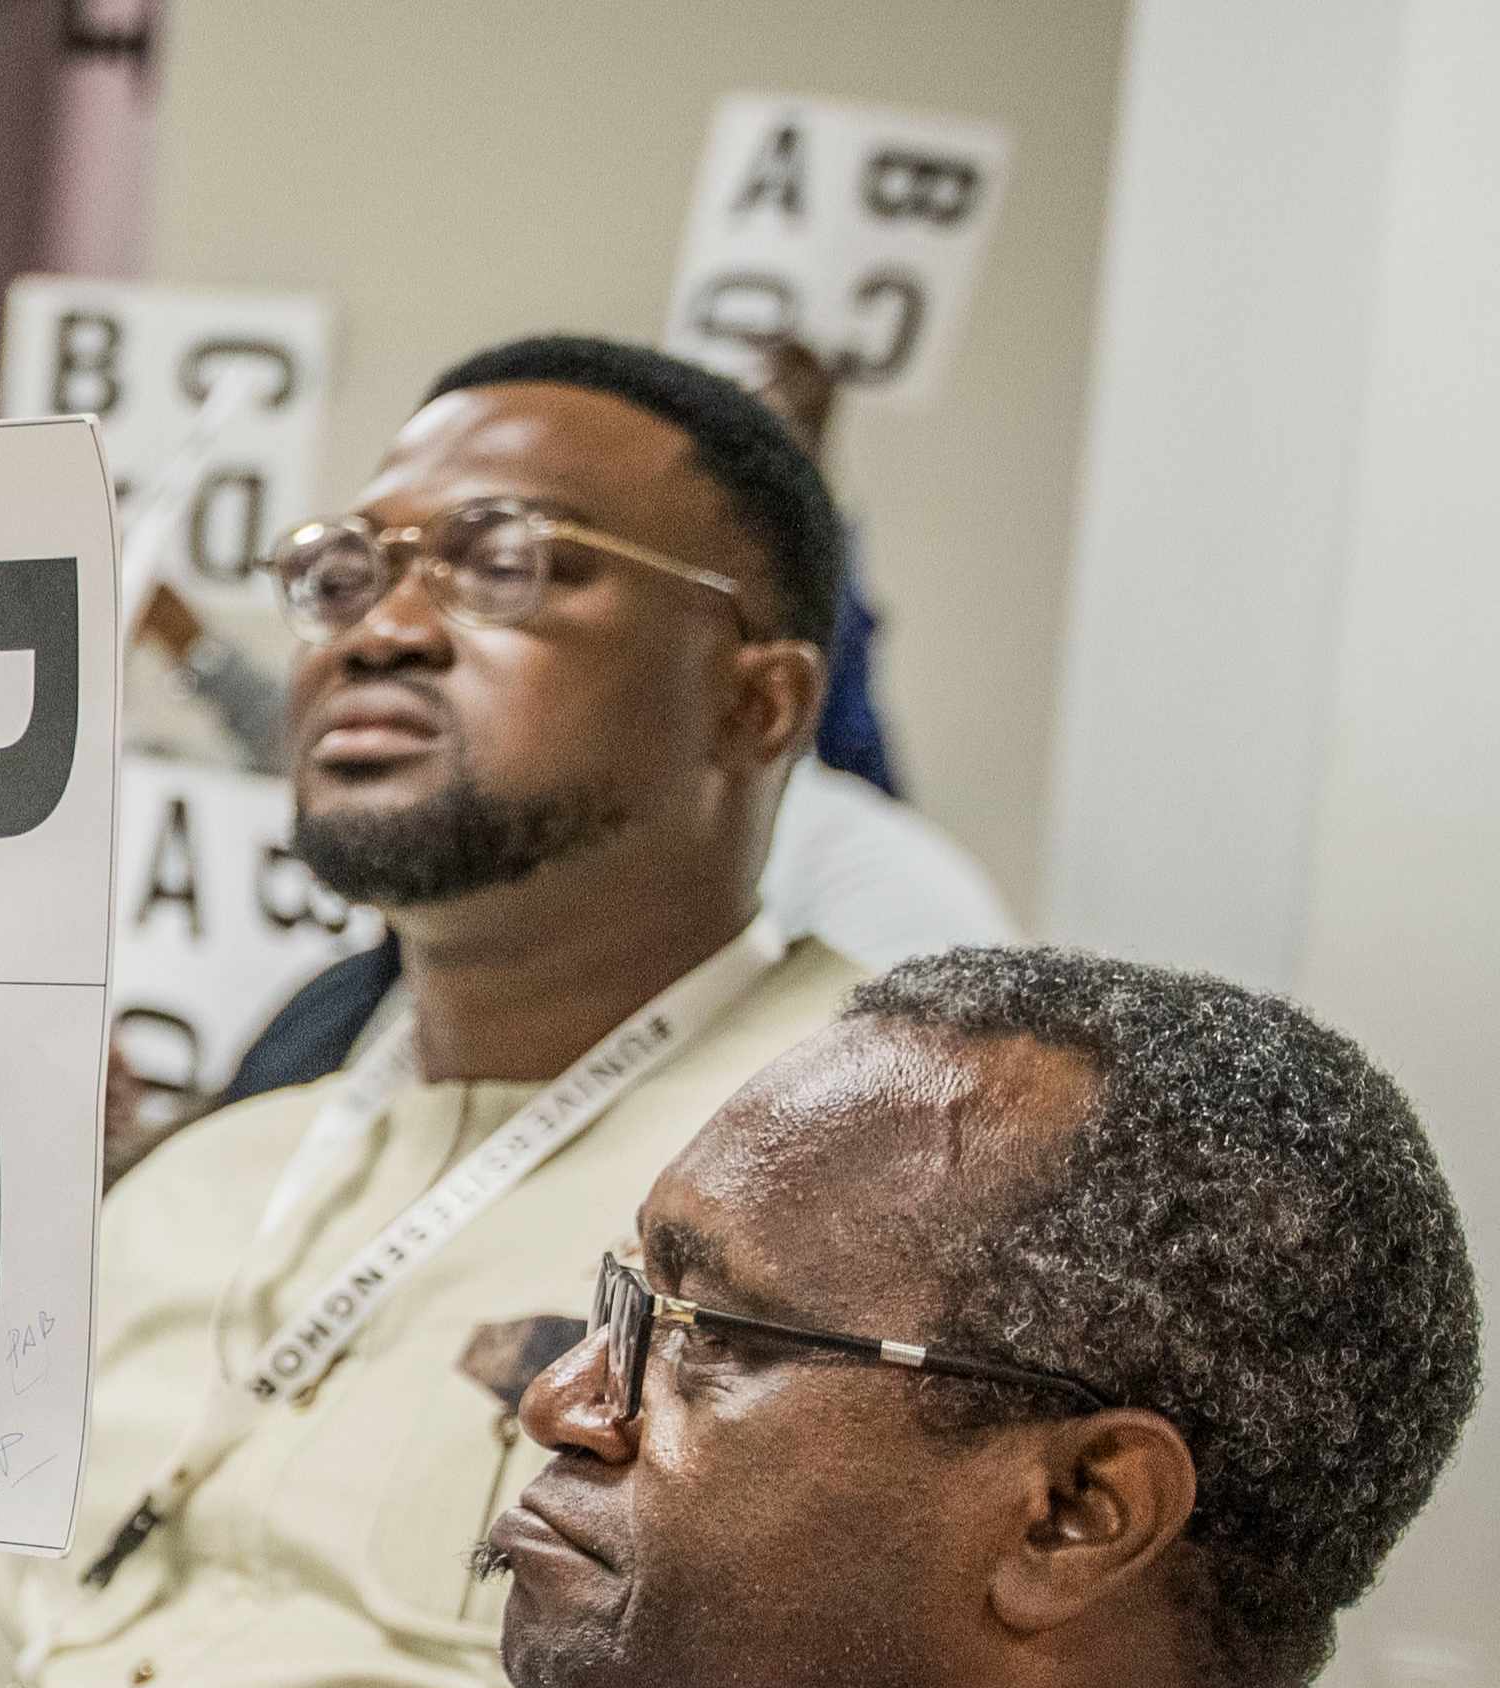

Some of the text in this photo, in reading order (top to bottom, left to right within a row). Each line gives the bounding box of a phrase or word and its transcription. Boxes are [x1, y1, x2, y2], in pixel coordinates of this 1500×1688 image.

[732, 124, 804, 216] A
[861, 151, 982, 227] B
[55, 310, 120, 415] B
[135, 797, 205, 940] A
